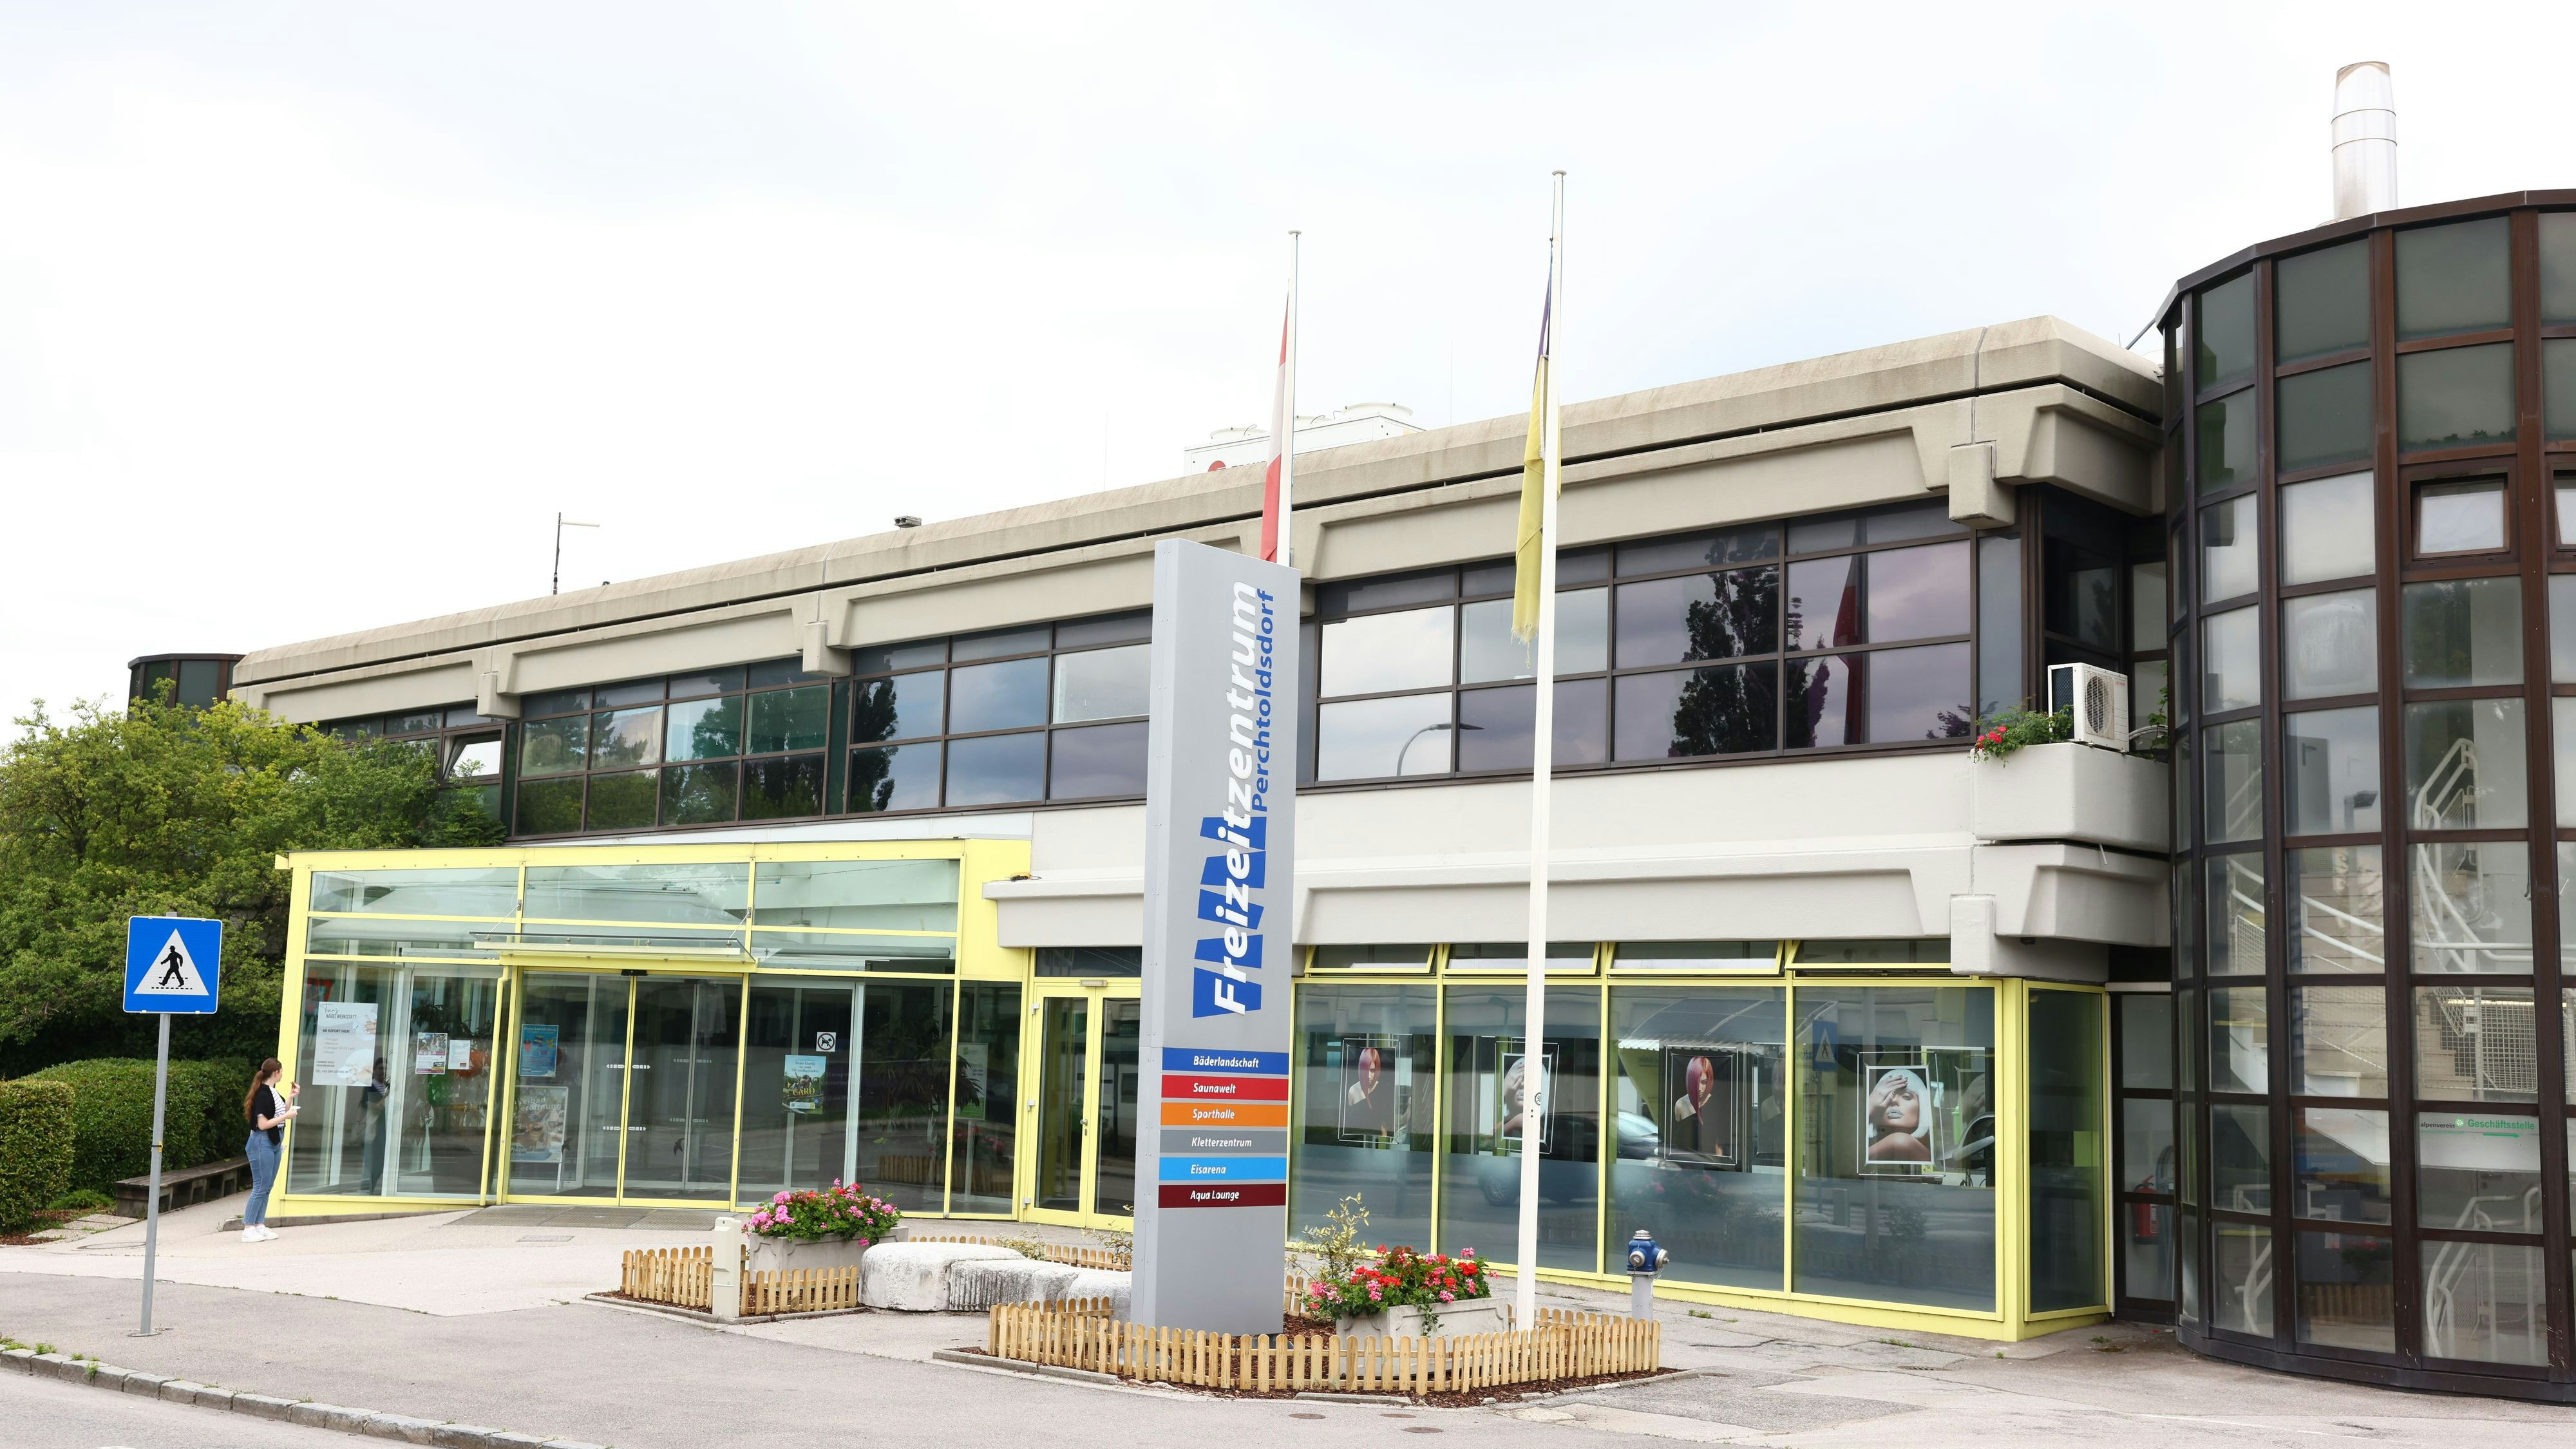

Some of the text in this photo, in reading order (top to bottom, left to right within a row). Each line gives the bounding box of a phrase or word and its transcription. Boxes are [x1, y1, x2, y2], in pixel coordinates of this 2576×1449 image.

[1251, 589, 1275, 812] Perchtoldsdorf
[1214, 580, 1257, 1016] Freizeitzentrum
[1193, 1056, 1259, 1068] Bäderlandschaft
[793, 1088, 815, 1096] CARD
[1193, 1083, 1236, 1094] Saunawelt
[1192, 1109, 1235, 1121] Sporthalle
[2467, 1119, 2535, 1130] Geschäftsstelle
[1191, 1137, 1252, 1147] Kletterzentrum
[1191, 1164, 1226, 1174] Eisarena
[1190, 1191, 1239, 1202] Aqua Lounge
